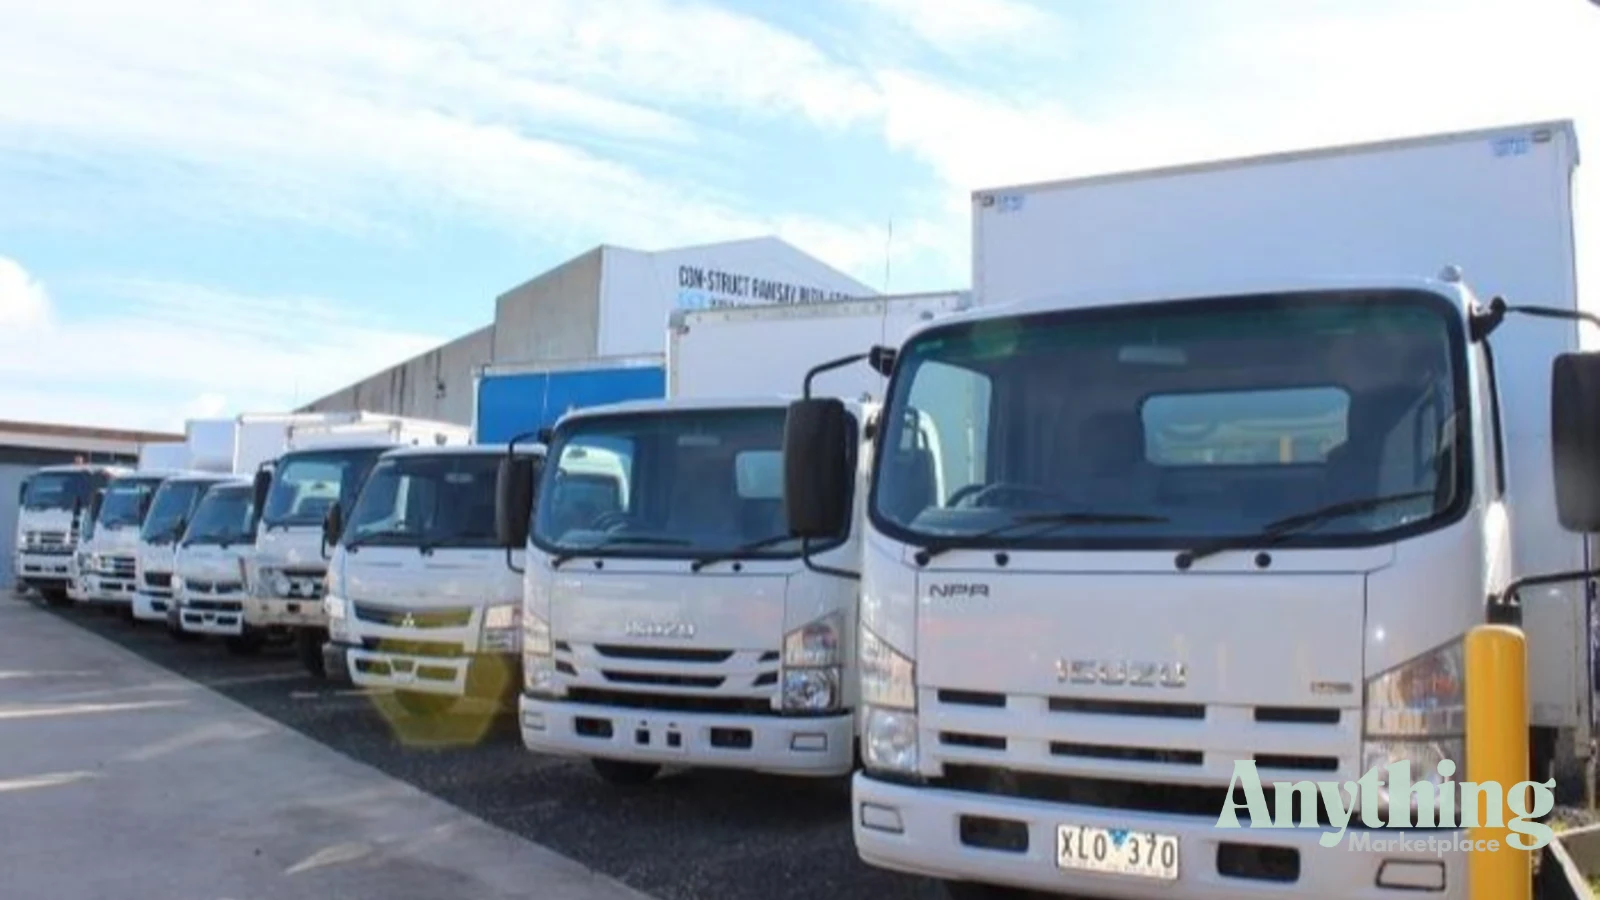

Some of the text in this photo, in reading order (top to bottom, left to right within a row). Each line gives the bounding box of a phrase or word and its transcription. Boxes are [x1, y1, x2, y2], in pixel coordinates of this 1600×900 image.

[1055, 658, 1187, 688] ISUZU
[1061, 830, 1175, 869] XLO 370
